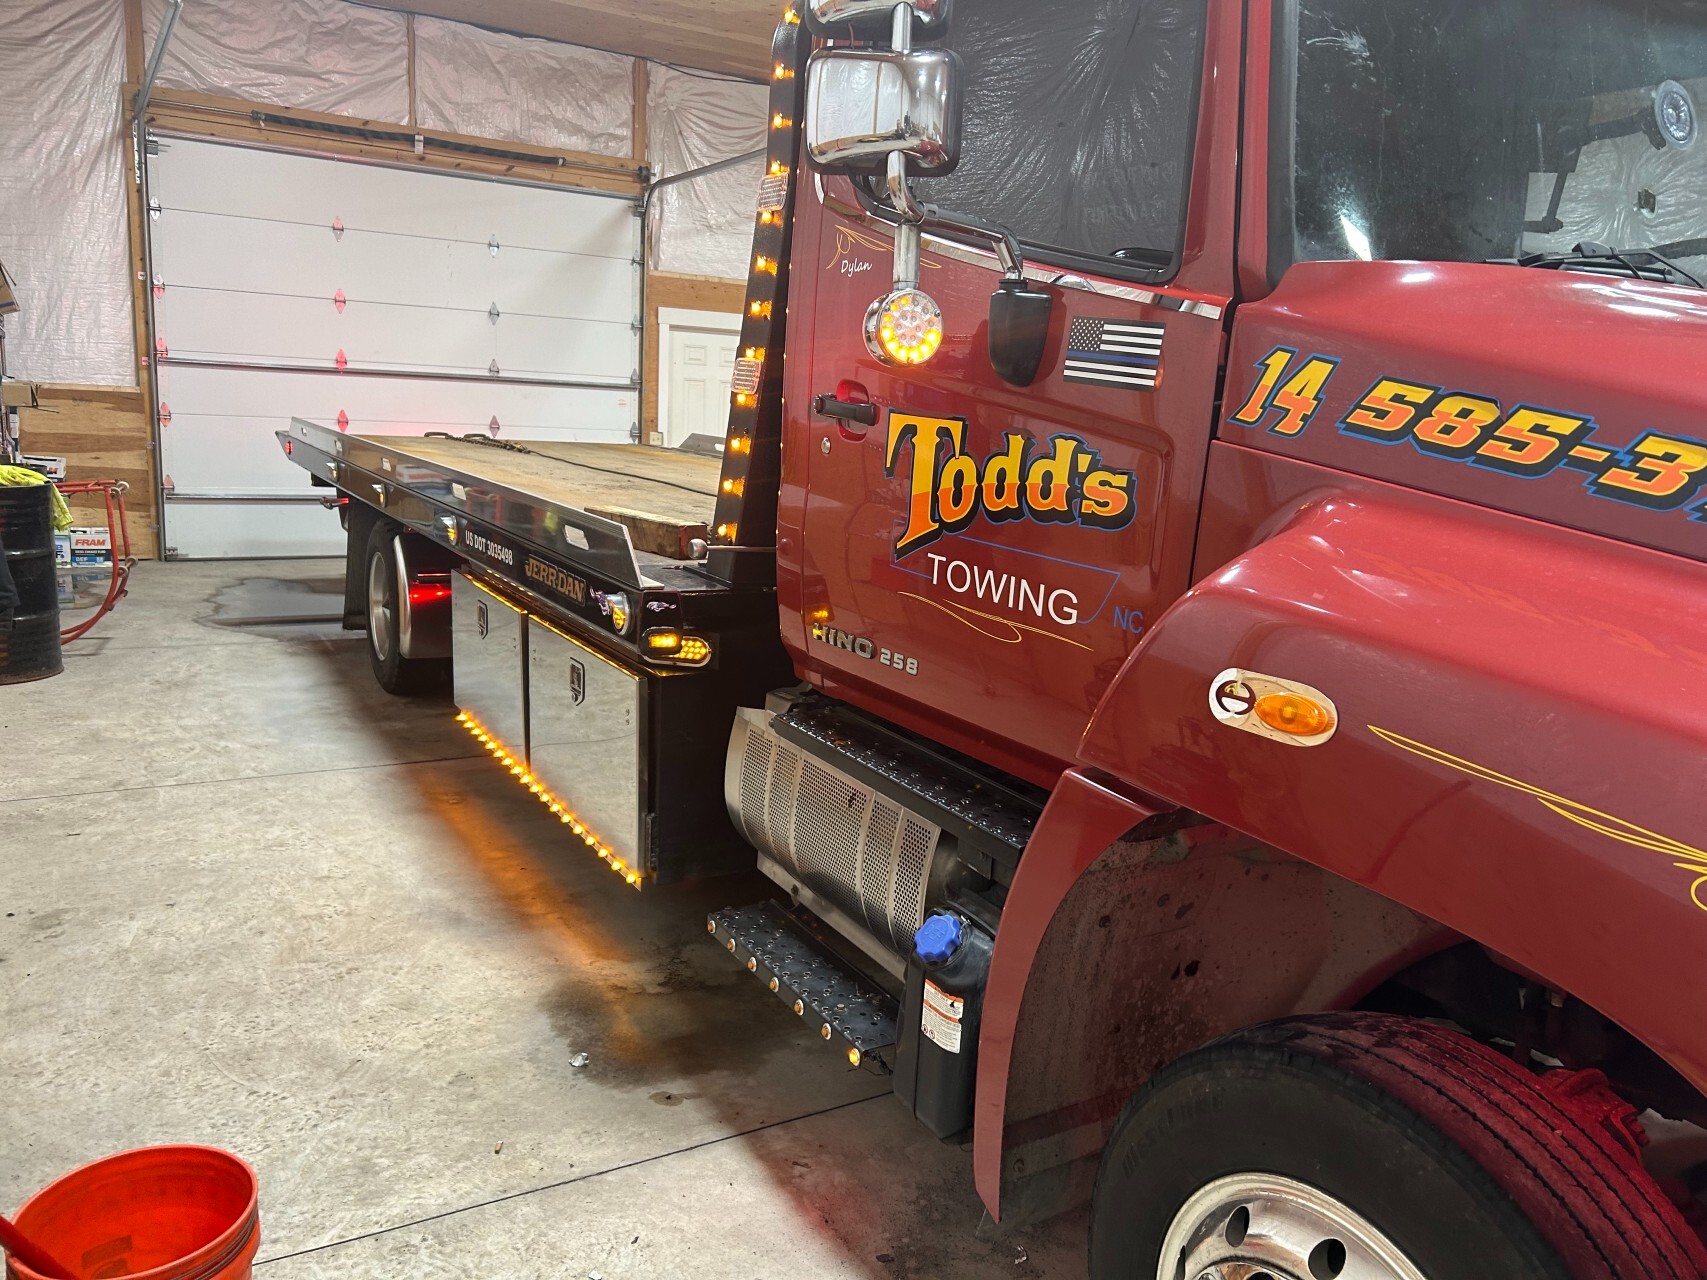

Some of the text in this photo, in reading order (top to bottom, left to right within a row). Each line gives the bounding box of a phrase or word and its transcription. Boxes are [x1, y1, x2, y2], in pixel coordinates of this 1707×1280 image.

[841, 257, 873, 278] Dylan
[1230, 346, 1707, 522] 14 585-3
[885, 409, 1135, 556] Todd's
[465, 529, 513, 566] US DOT 3035498
[927, 552, 1079, 625] TOWING
[1113, 606, 1145, 634] NC
[812, 622, 919, 676] HINO 258
